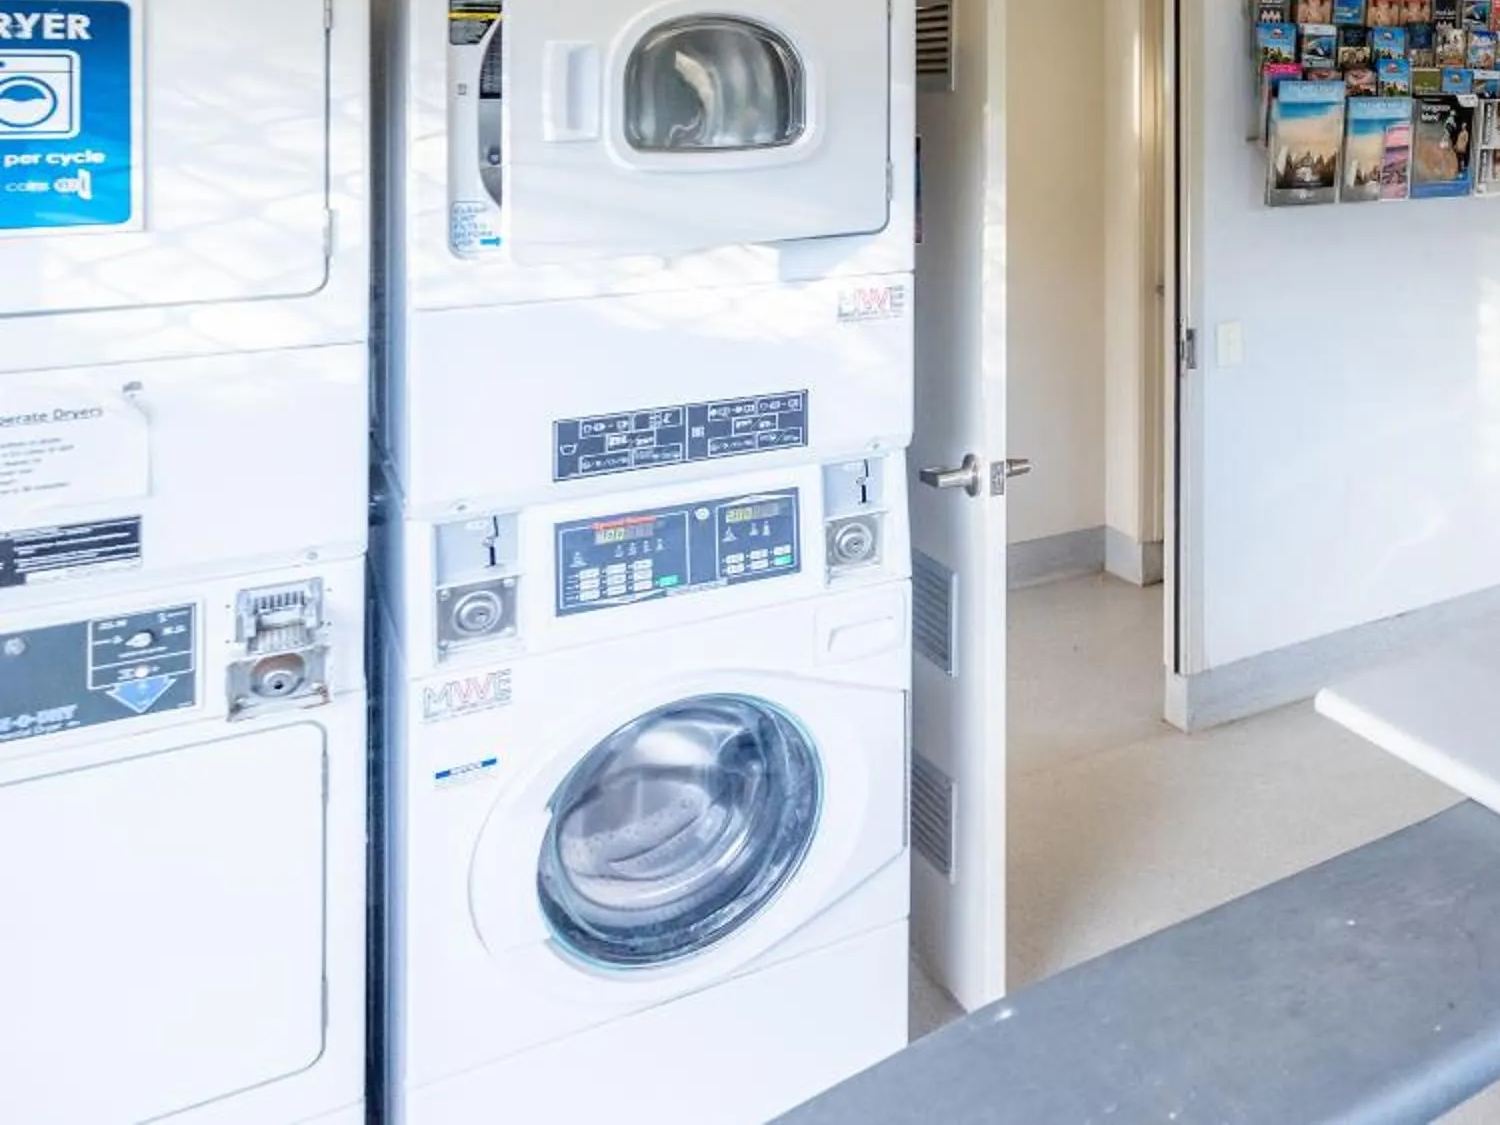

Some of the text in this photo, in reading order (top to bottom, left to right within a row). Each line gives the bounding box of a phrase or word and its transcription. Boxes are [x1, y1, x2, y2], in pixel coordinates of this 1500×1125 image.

[4, 150, 106, 168] per cycle
[423, 670, 512, 719] MWE
